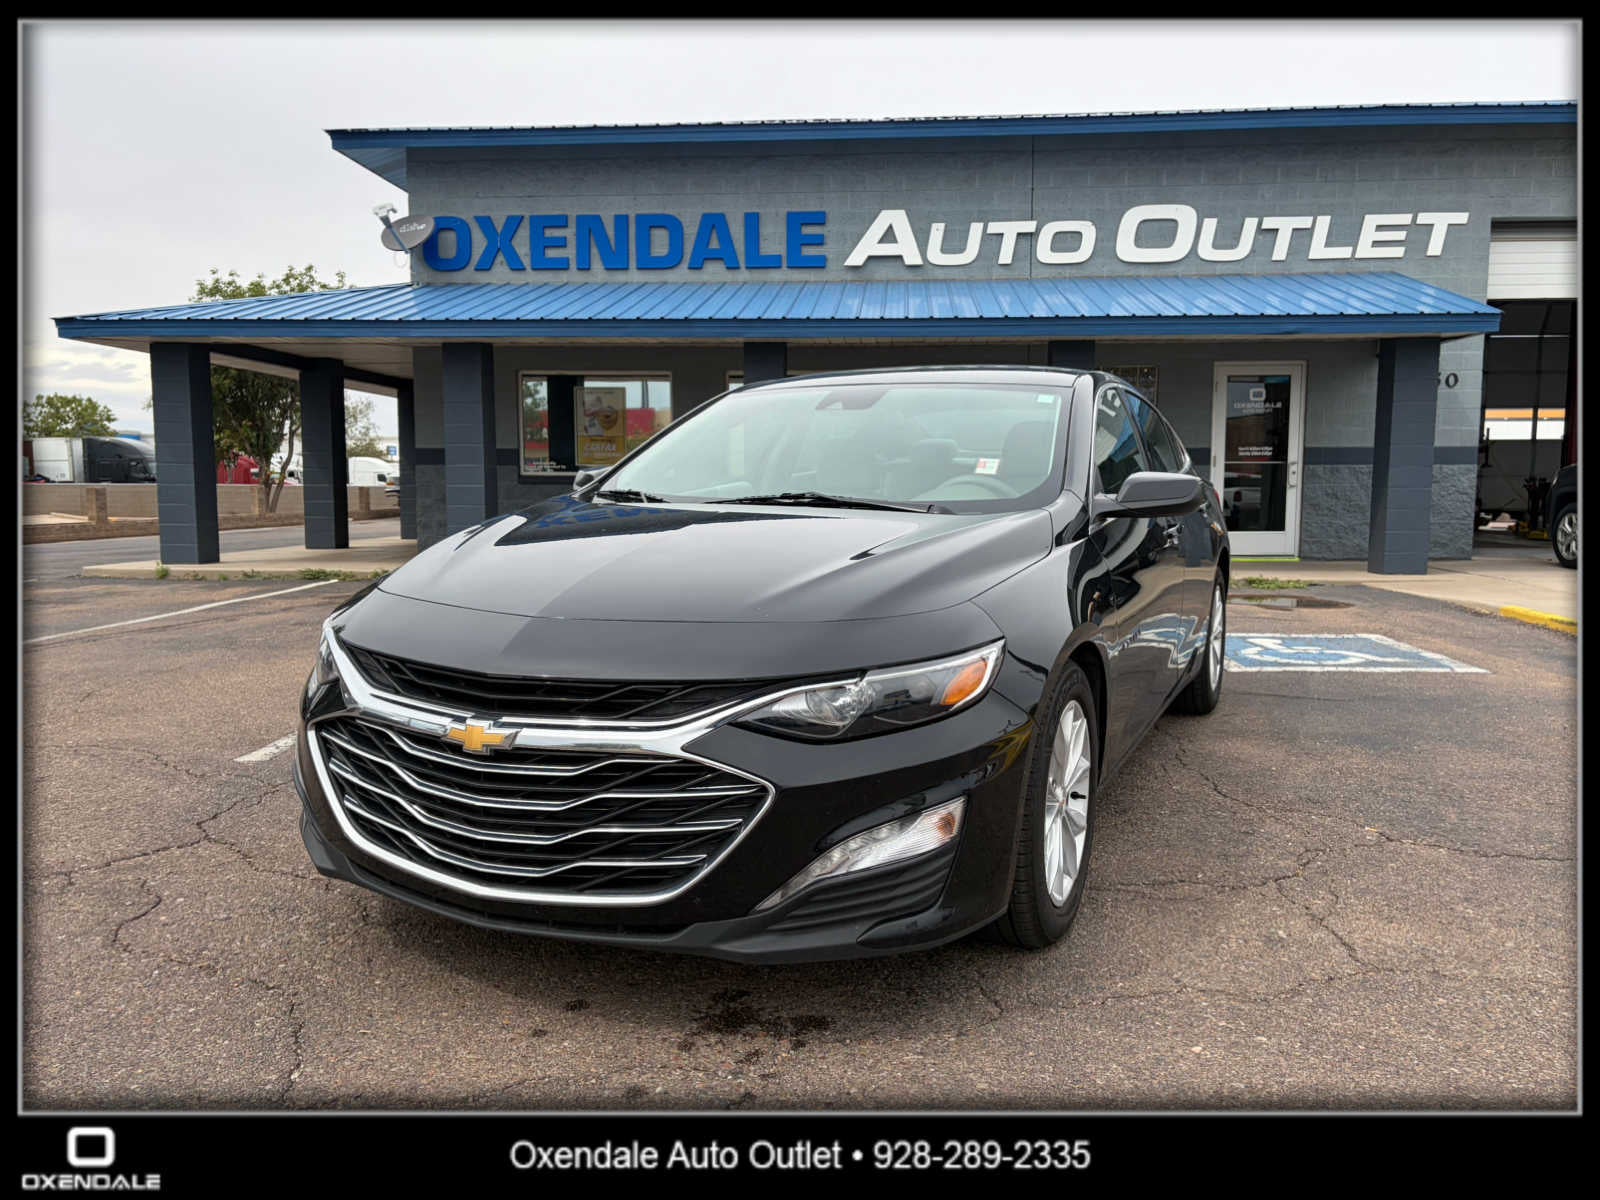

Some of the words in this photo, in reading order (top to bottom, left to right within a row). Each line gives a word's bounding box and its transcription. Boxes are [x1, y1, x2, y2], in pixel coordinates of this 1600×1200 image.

[422, 211, 827, 272] OXENDALE
[843, 209, 1097, 266] AUTO
[1115, 204, 1470, 263] OUTLET
